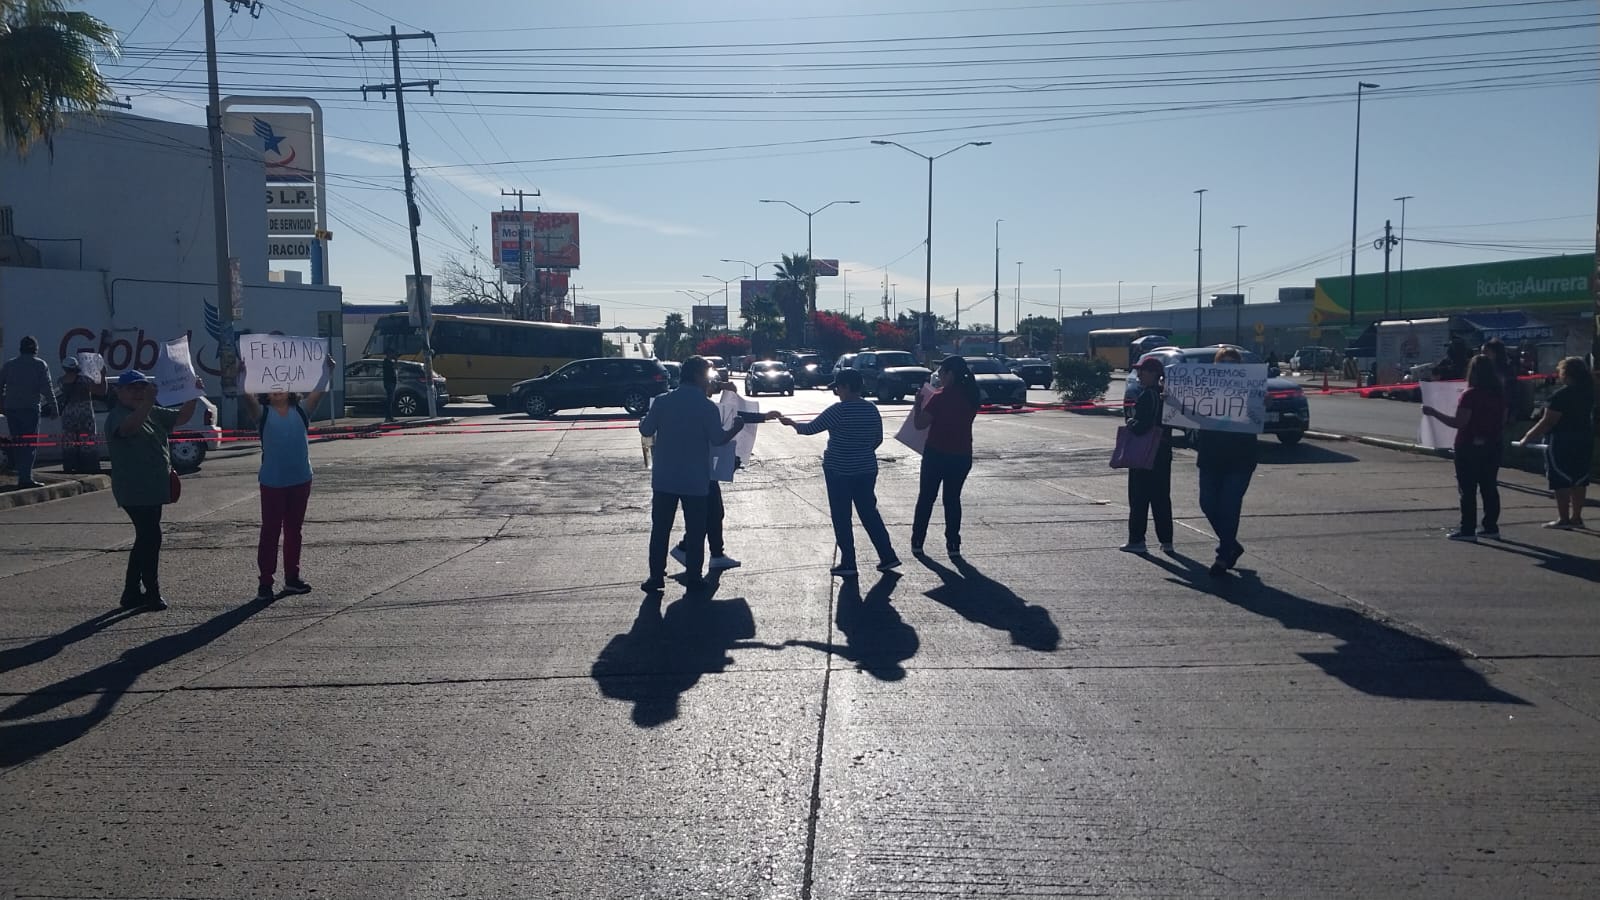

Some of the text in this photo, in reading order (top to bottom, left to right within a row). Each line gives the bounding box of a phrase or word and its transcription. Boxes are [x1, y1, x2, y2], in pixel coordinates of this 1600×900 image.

[280, 190, 310, 204] L.P.
[269, 219, 312, 230] DE SERVICIO
[1476, 276, 1588, 298] BodegaAurrera
[59, 328, 192, 371] Globl
[250, 341, 323, 362] FERIA NO
[261, 365, 305, 384] AGUA
[1168, 366, 1188, 377] NO
[1182, 396, 1244, 417] AGUA
